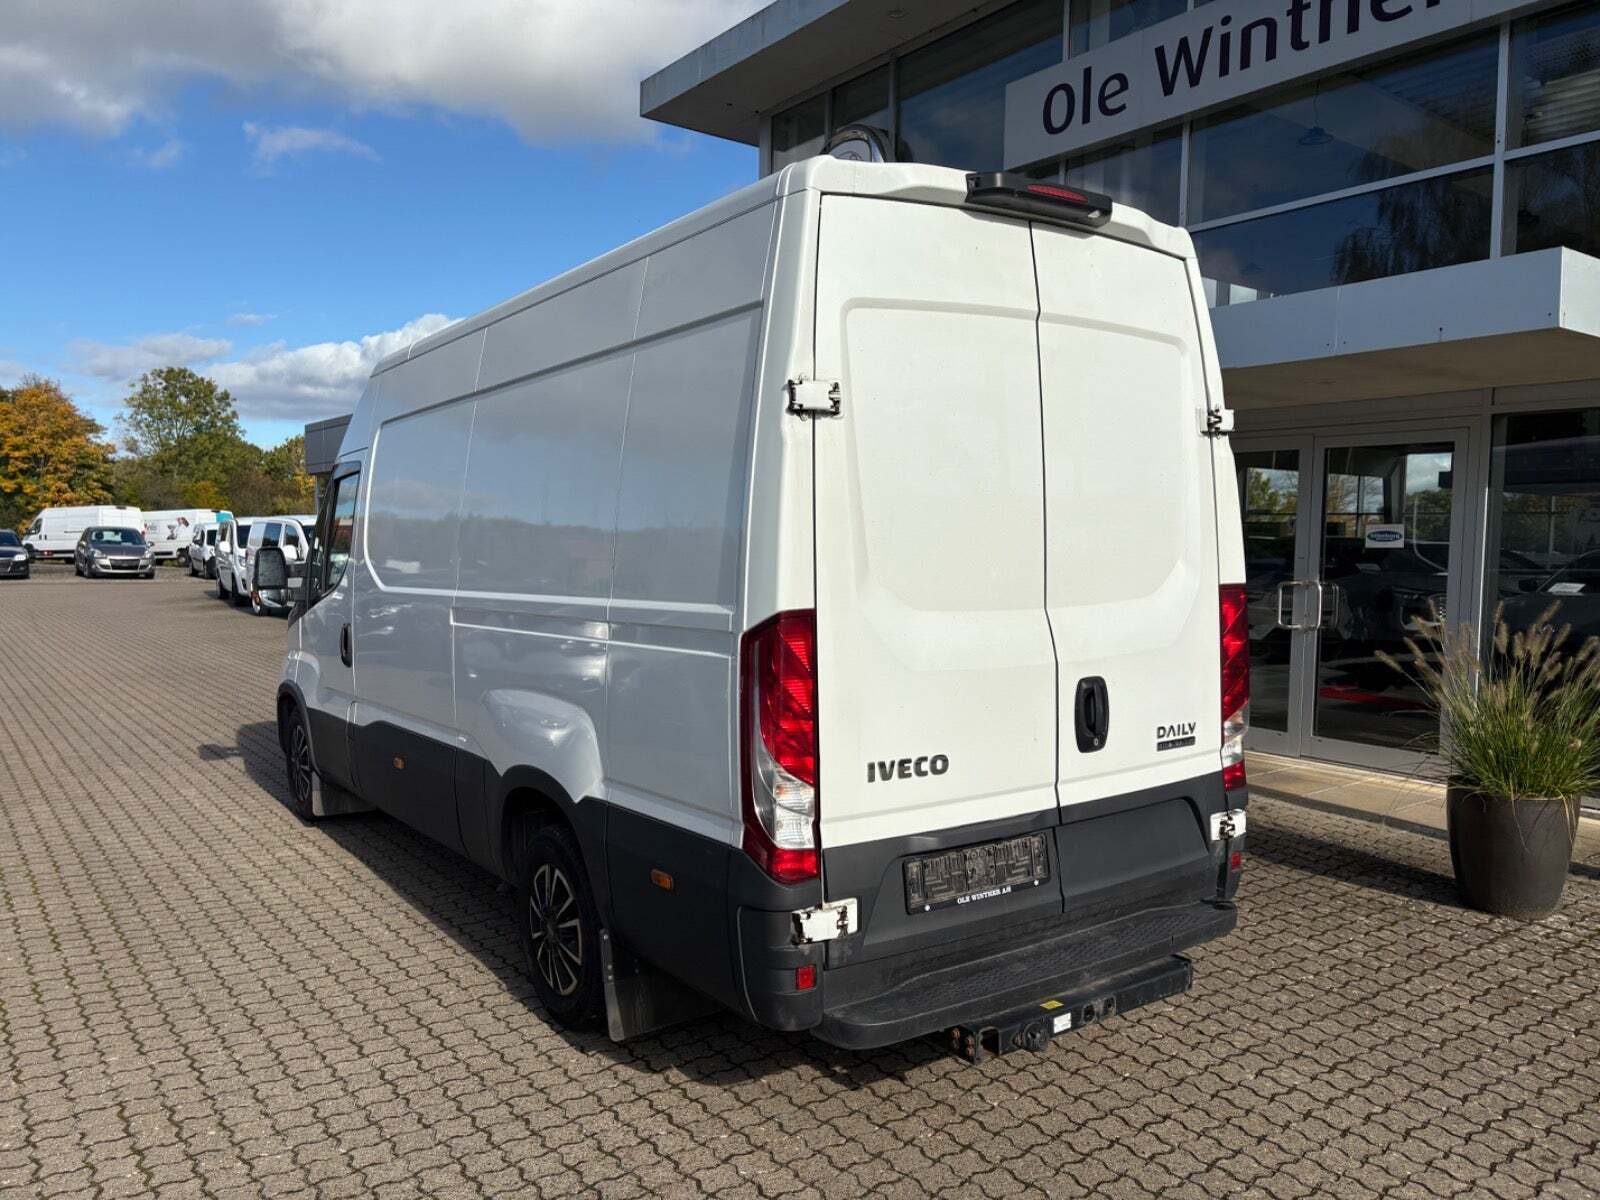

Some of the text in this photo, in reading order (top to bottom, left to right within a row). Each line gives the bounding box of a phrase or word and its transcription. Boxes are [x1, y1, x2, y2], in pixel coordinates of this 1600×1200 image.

[1042, 66, 1129, 136] Ole
[1157, 722, 1196, 739] DAILY
[867, 754, 949, 783] IVECO
